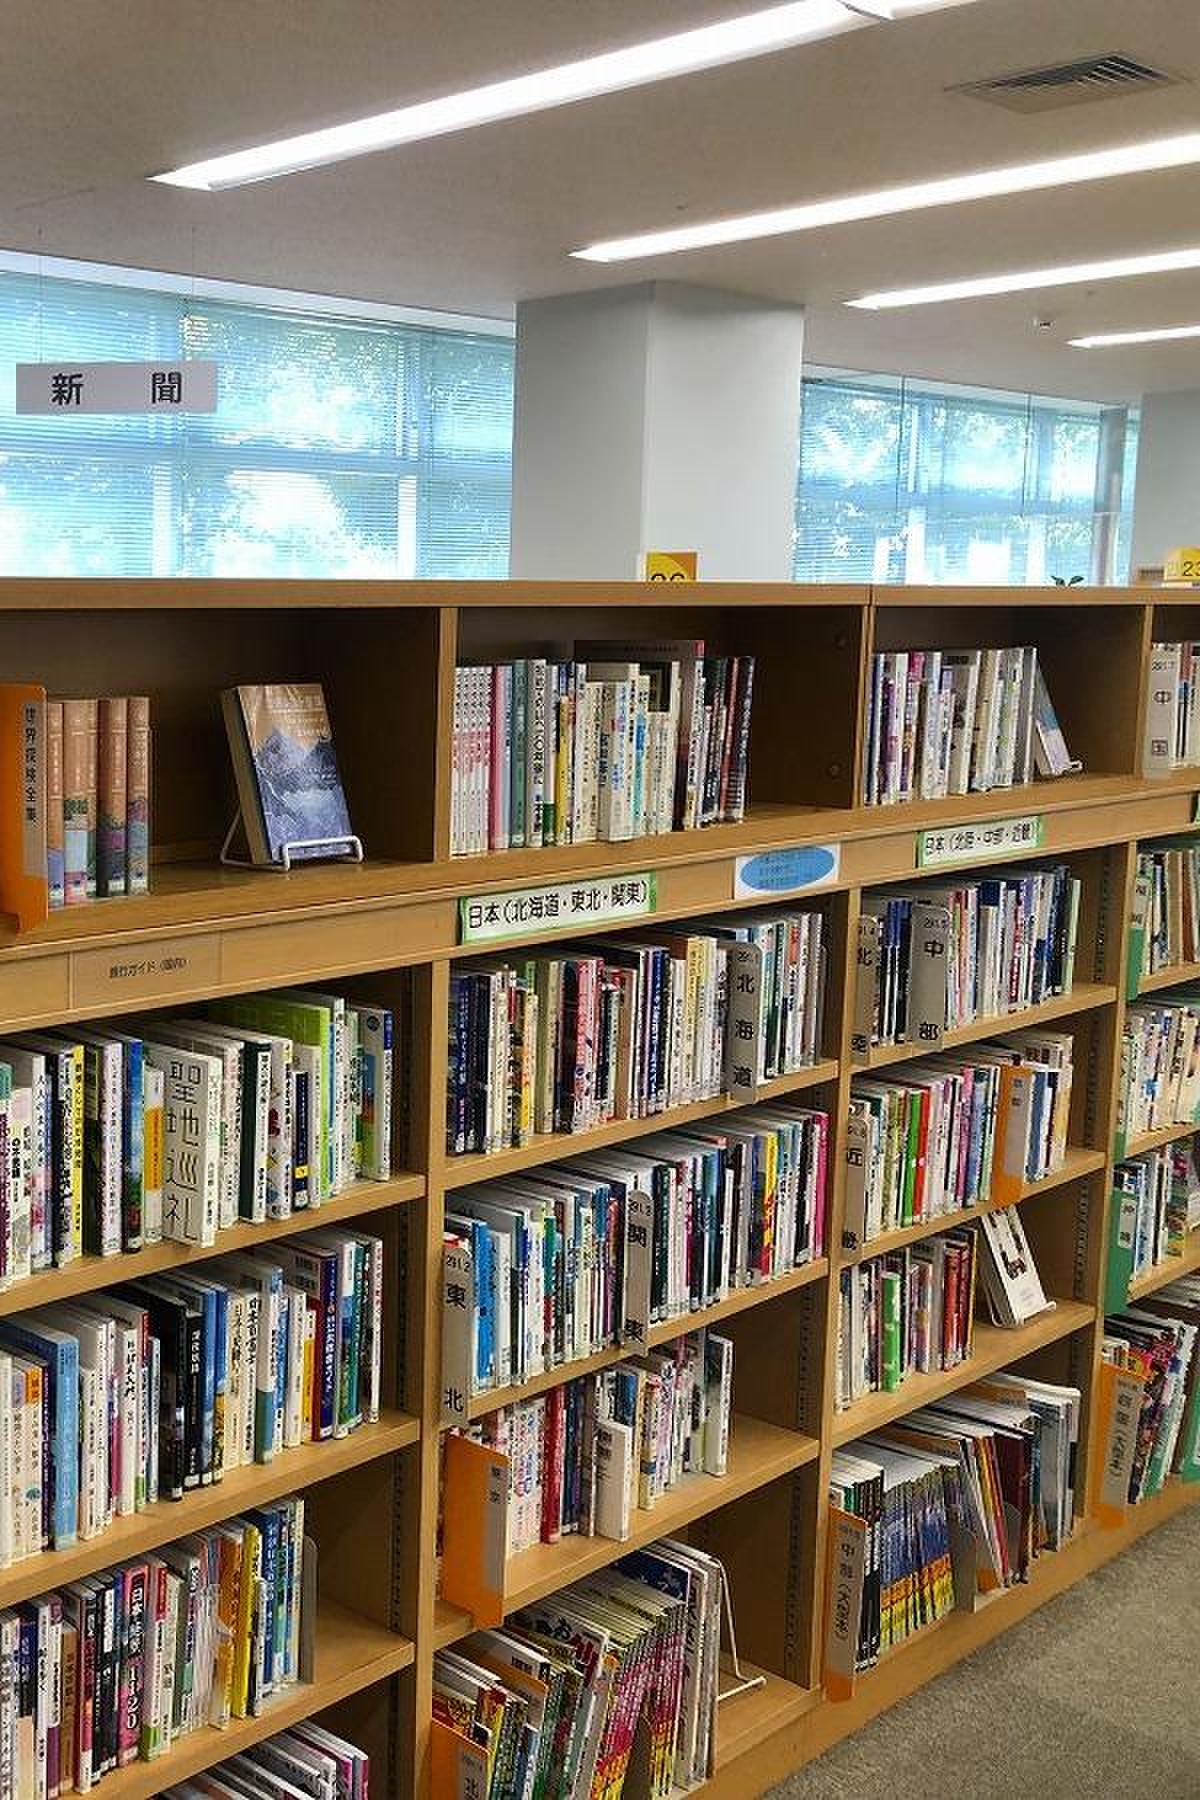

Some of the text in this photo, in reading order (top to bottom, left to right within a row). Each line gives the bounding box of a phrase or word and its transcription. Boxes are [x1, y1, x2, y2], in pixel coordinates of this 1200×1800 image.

[51, 372, 182, 405] 新聞
[164, 1059, 202, 1242] 聖地巡礼
[444, 1283, 467, 1412] 東北
